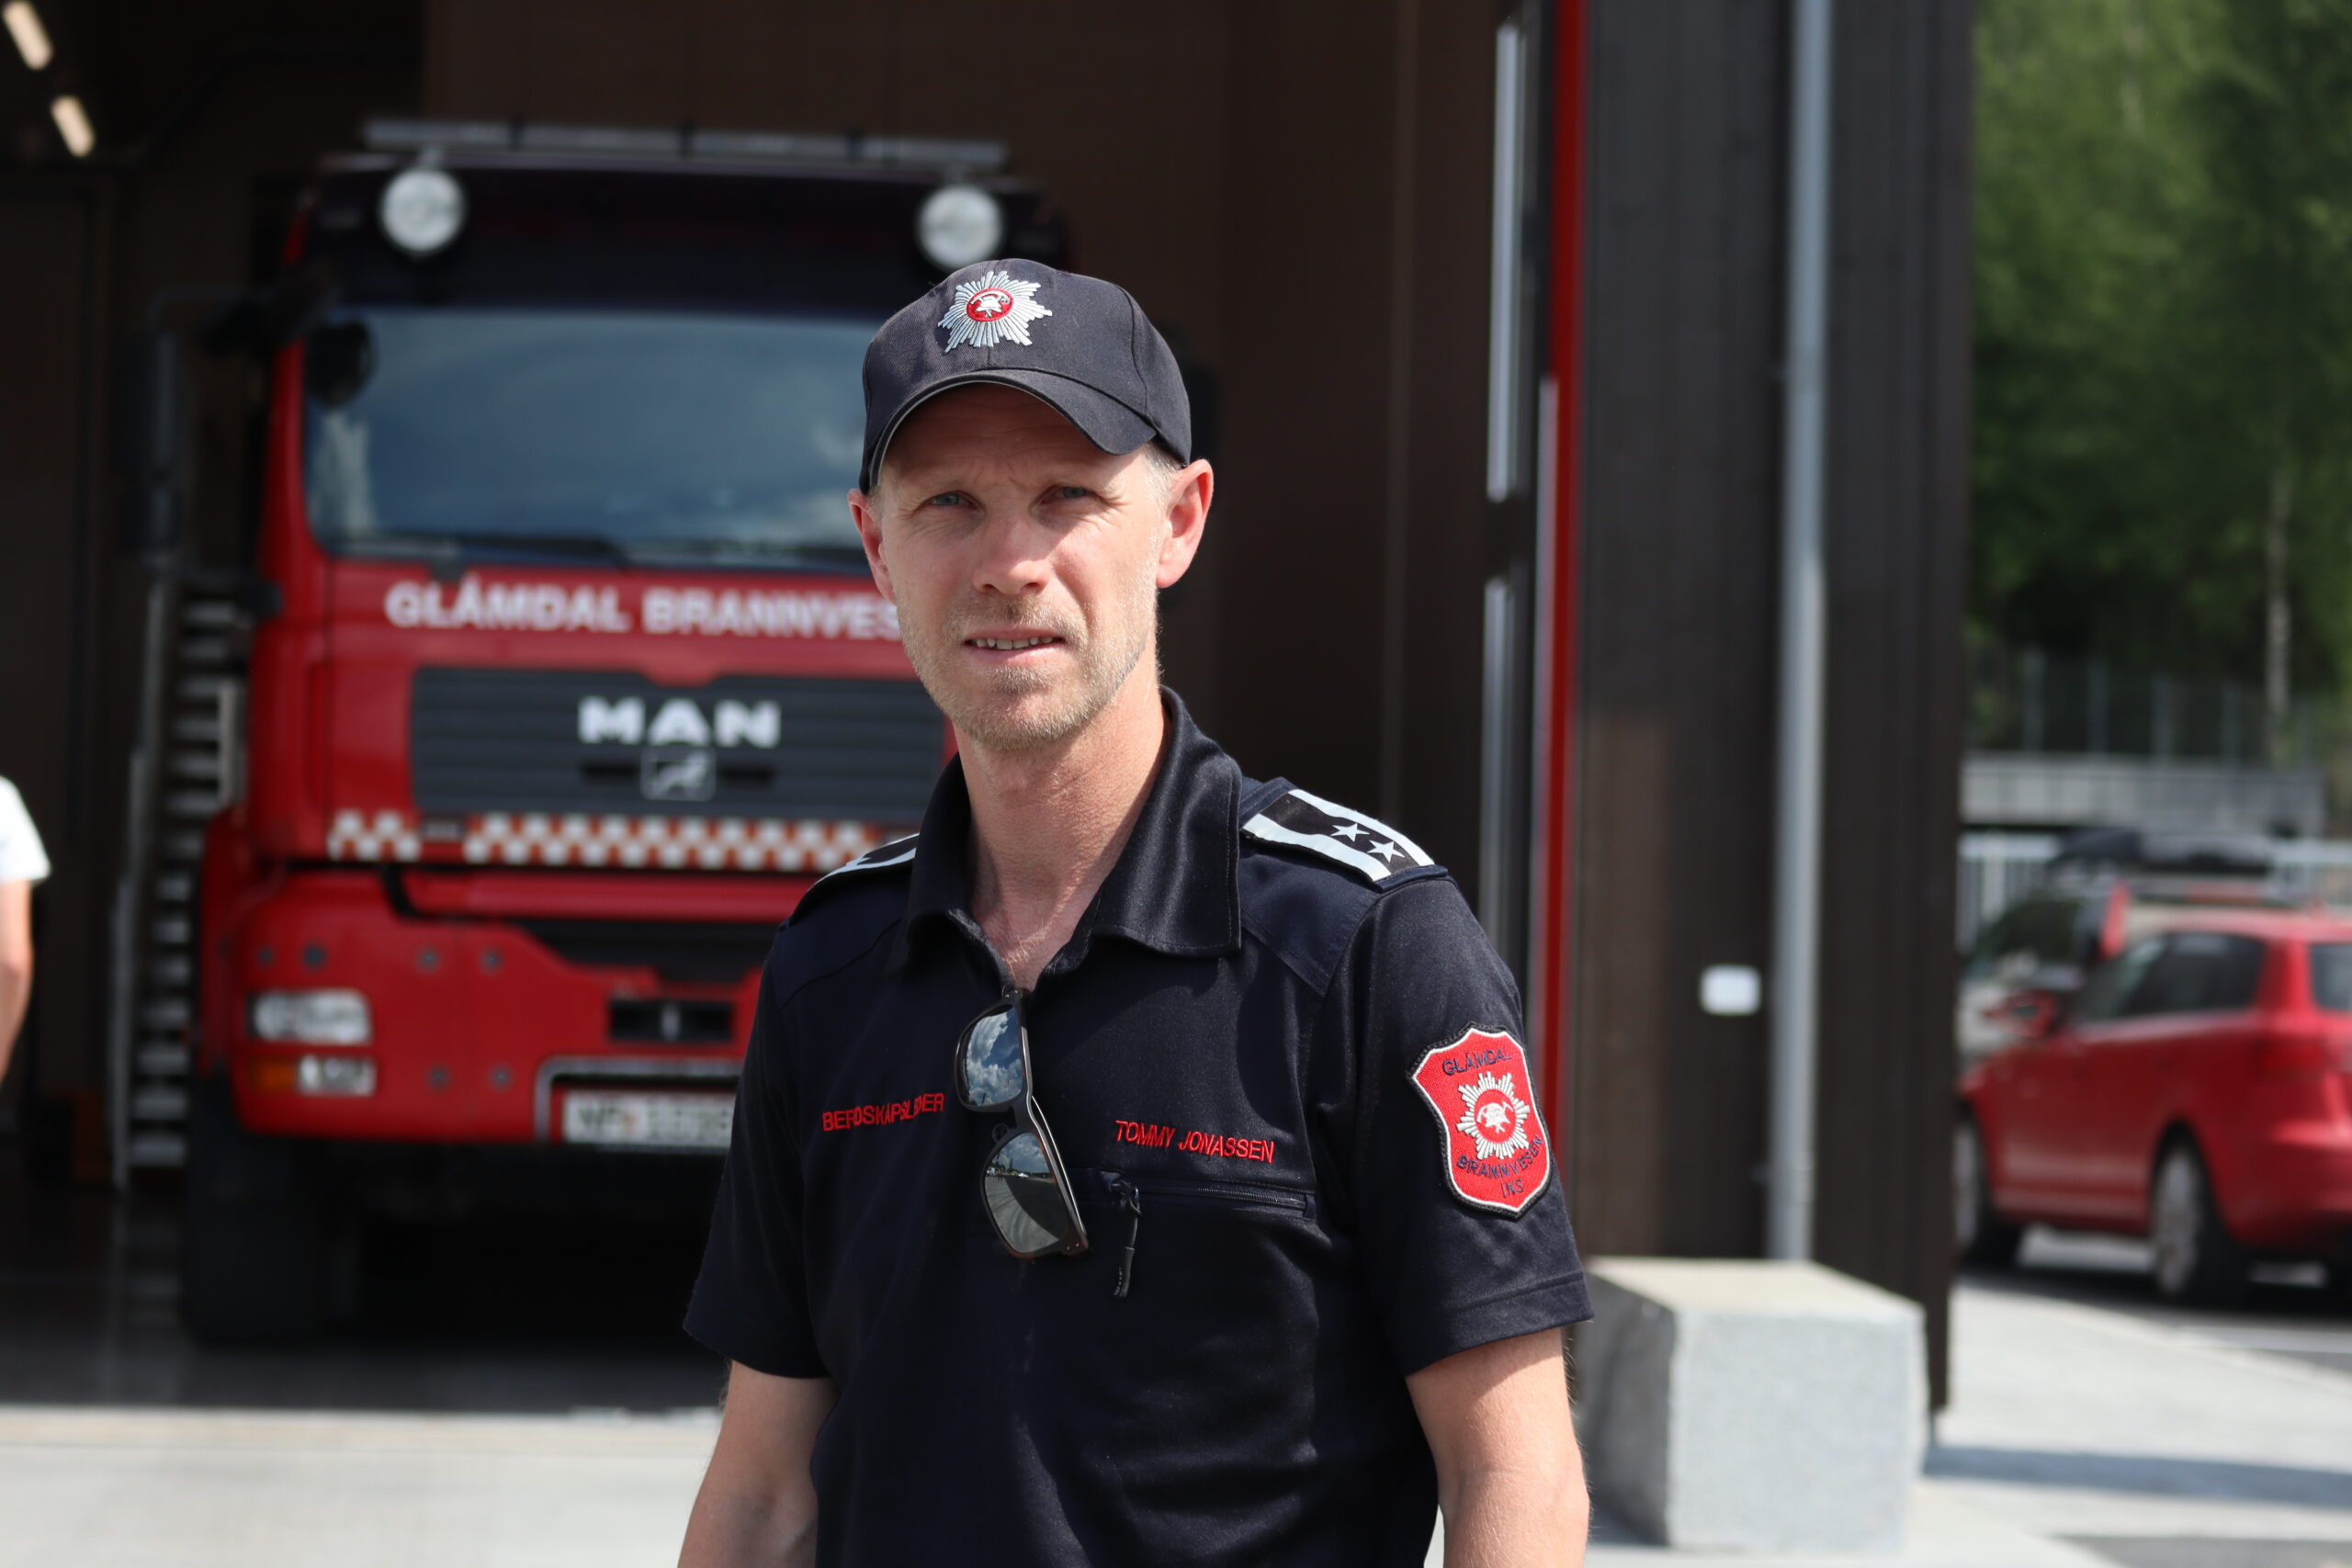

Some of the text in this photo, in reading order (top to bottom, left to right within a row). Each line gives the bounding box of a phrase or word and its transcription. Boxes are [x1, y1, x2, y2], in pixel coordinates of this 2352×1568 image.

[384, 572, 630, 632] GLÅMDAL
[578, 695, 781, 749] MAN
[1115, 1120, 1275, 1164] TOMMY JONASSEN
[1457, 1135, 1544, 1179] BRANNVESEN
[1500, 1179, 1524, 1198] IKS
